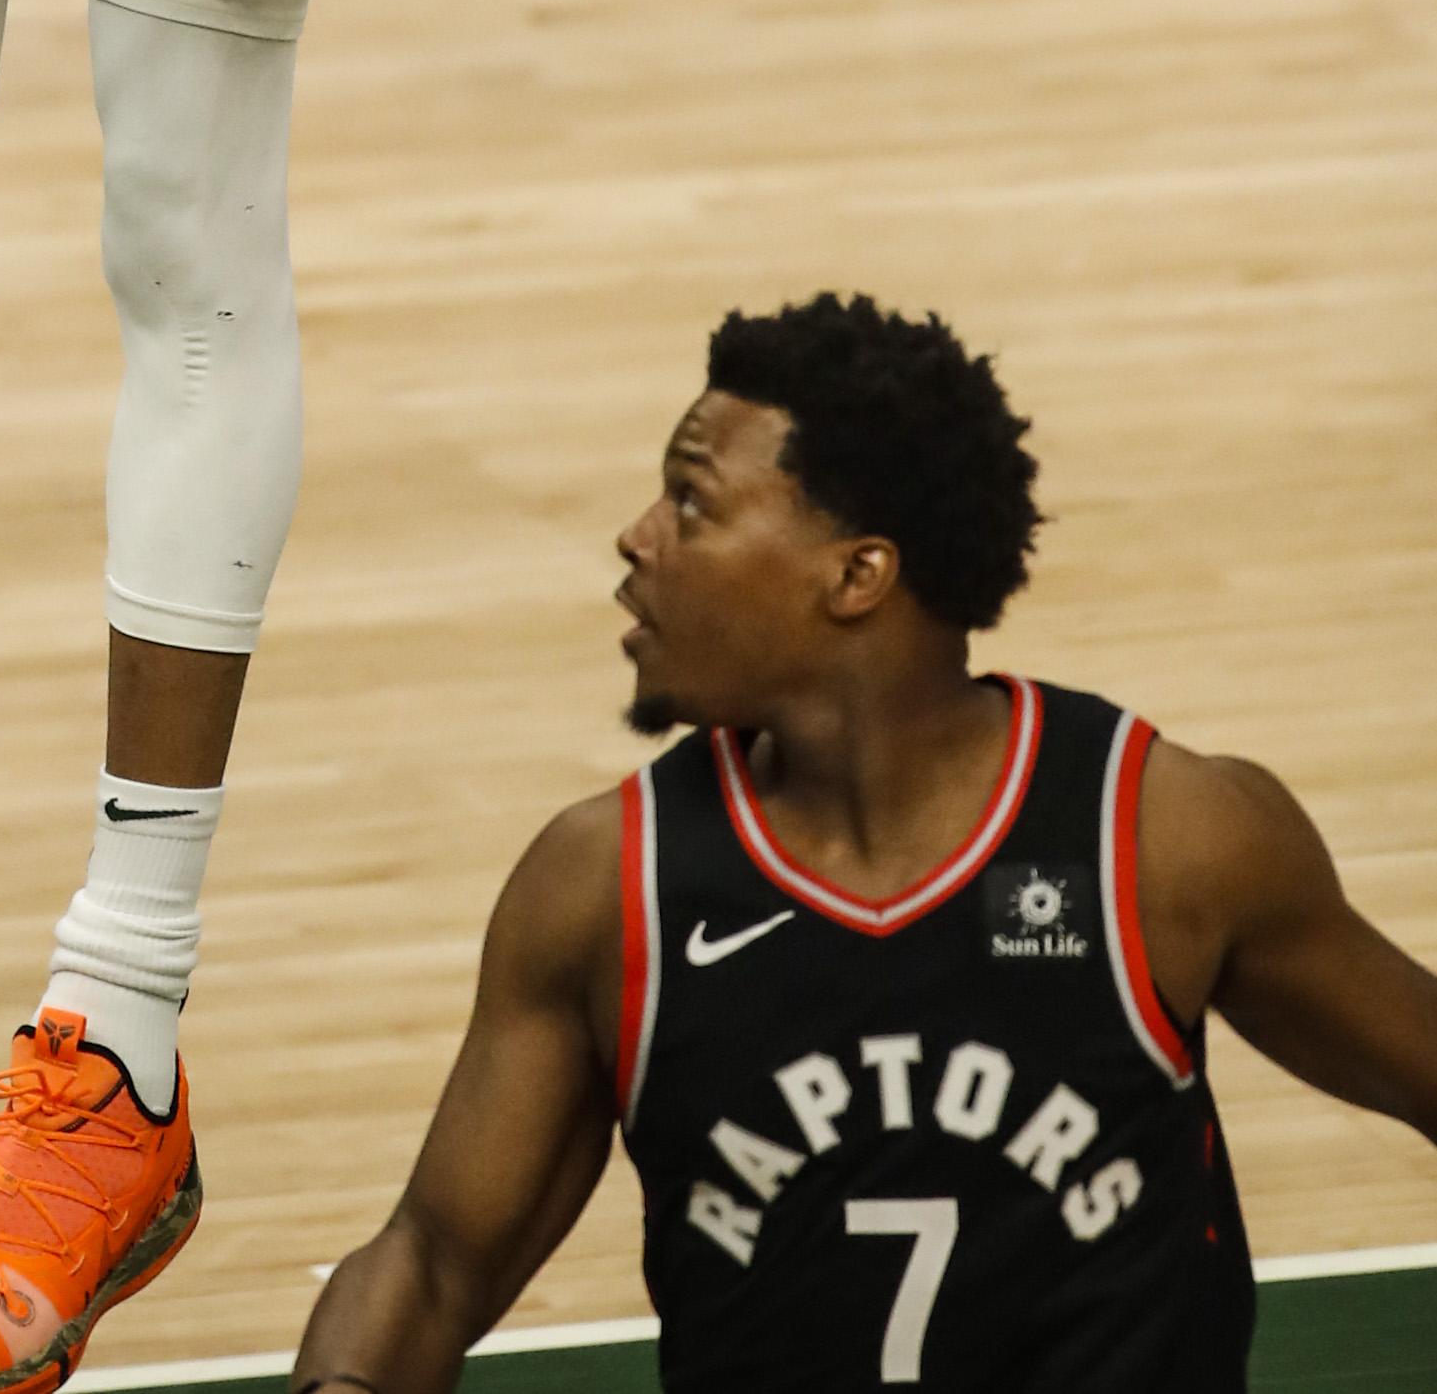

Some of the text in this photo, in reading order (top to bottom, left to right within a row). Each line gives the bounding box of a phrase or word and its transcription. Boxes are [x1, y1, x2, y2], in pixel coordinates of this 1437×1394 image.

[991, 932, 1089, 957] Sun Life
[687, 1032, 1144, 1269] RAPTORS
[844, 1197, 958, 1383] 7
